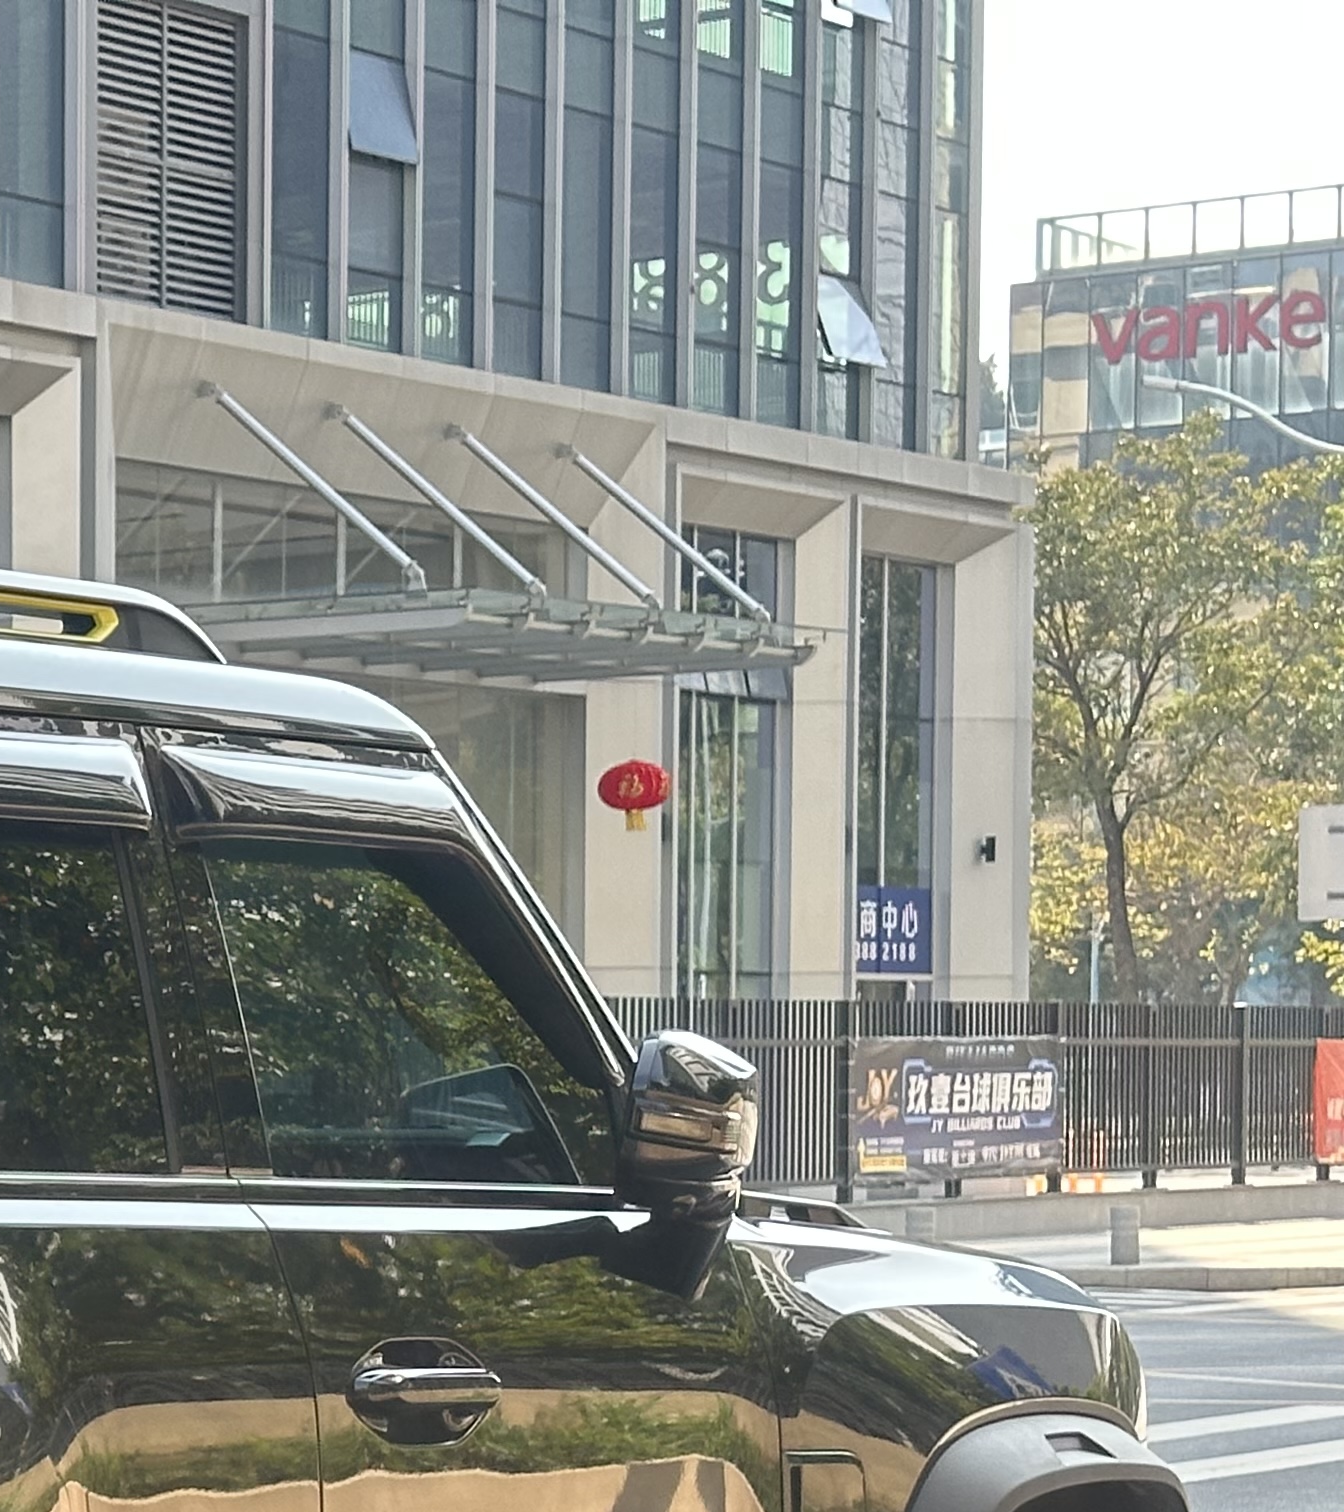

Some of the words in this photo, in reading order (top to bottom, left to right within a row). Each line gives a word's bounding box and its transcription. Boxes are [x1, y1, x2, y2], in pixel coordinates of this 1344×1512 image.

[1092, 289, 1326, 365] vanke
[859, 900, 918, 939] 商中心
[882, 941, 916, 962] 2188
[906, 1071, 1053, 1115] 玖壹台球俱乐部
[997, 1115, 1021, 1130] CLUB
